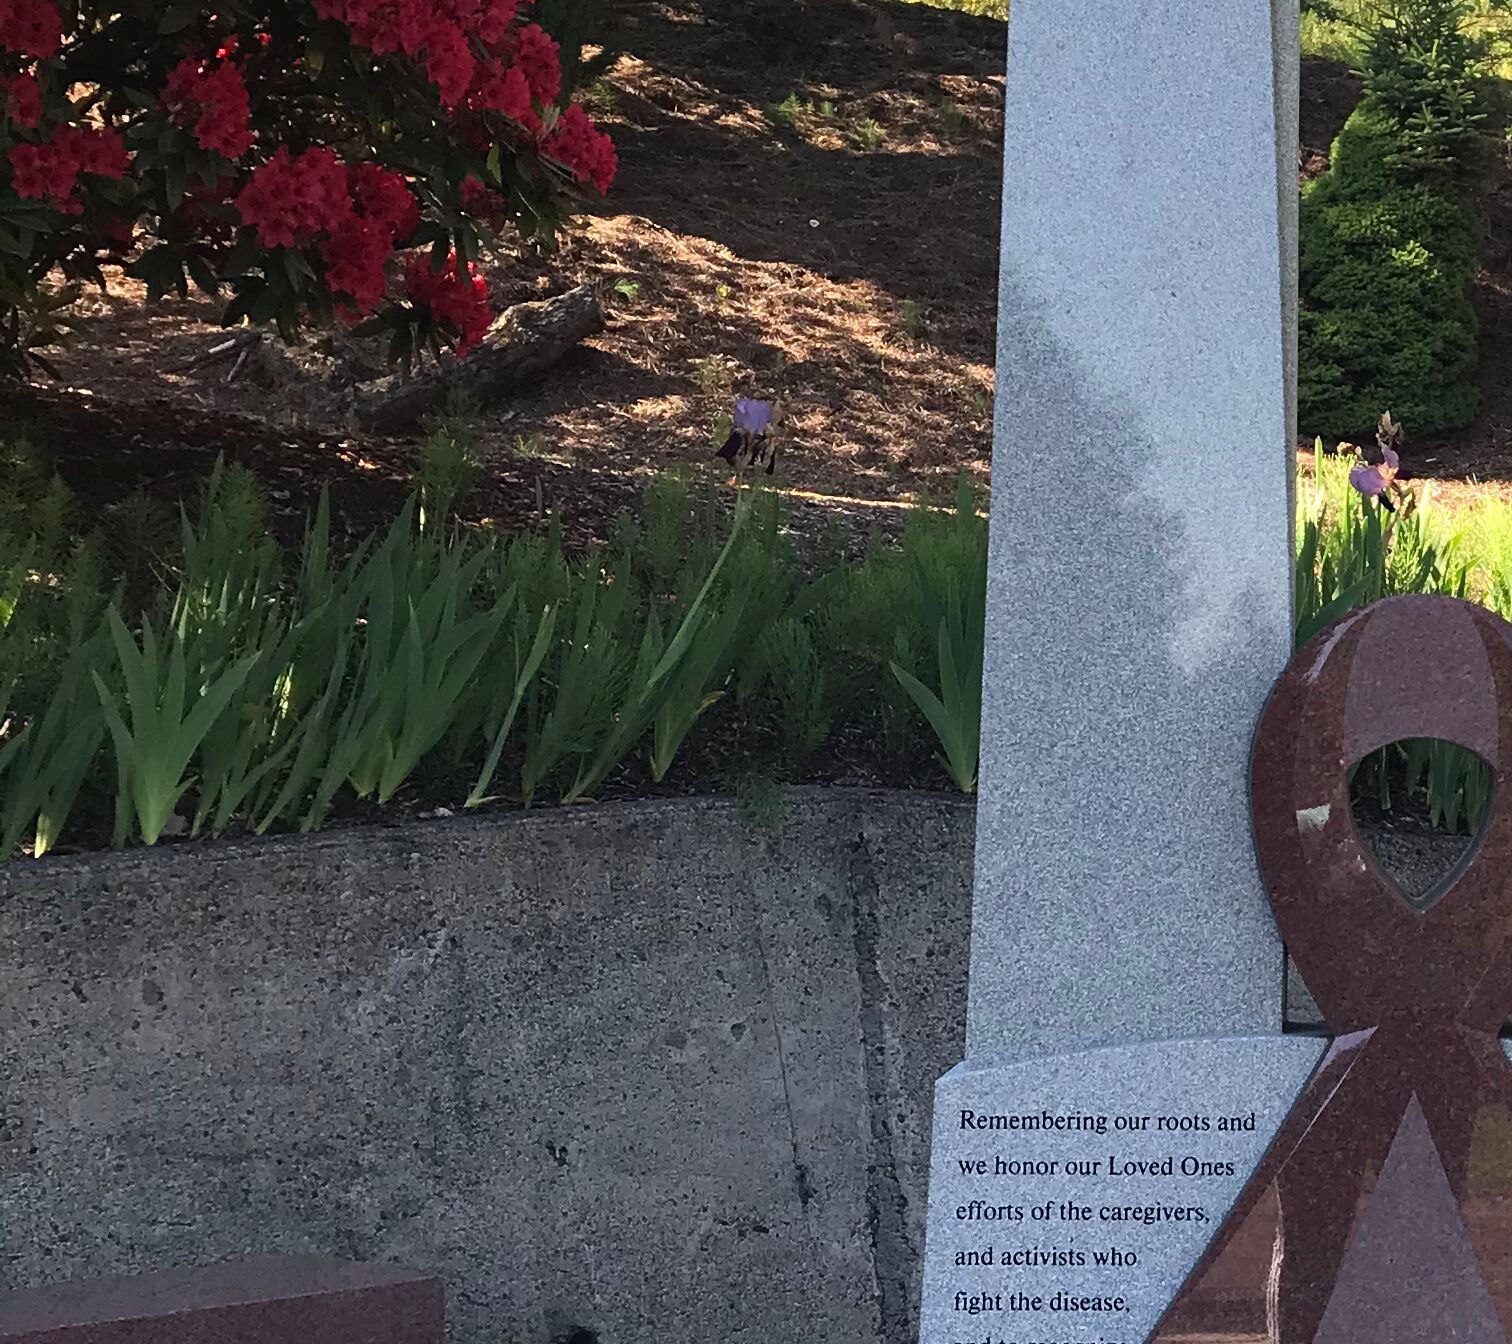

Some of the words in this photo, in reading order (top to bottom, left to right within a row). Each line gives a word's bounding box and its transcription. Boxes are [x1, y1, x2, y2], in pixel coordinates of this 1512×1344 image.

[960, 1110, 1107, 1134] Remembering
[1115, 1117, 1150, 1130] our
[1158, 1115, 1210, 1131] roots
[1218, 1113, 1255, 1131] and
[959, 1161, 986, 1174] we
[995, 1156, 1058, 1175] honor
[1065, 1162, 1101, 1175] our
[1109, 1156, 1172, 1176] Loved
[1181, 1157, 1234, 1176] Ones
[957, 1201, 1023, 1220] efforts
[1032, 1201, 1055, 1220] of
[1060, 1201, 1092, 1220] the
[1100, 1202, 1209, 1225] caregivers,
[955, 1247, 993, 1265] and
[1001, 1246, 1085, 1266] activists
[1093, 1247, 1137, 1266] who
[955, 1291, 1002, 1315] fight
[1010, 1292, 1042, 1311] the
[1050, 1292, 1129, 1312] disease,
